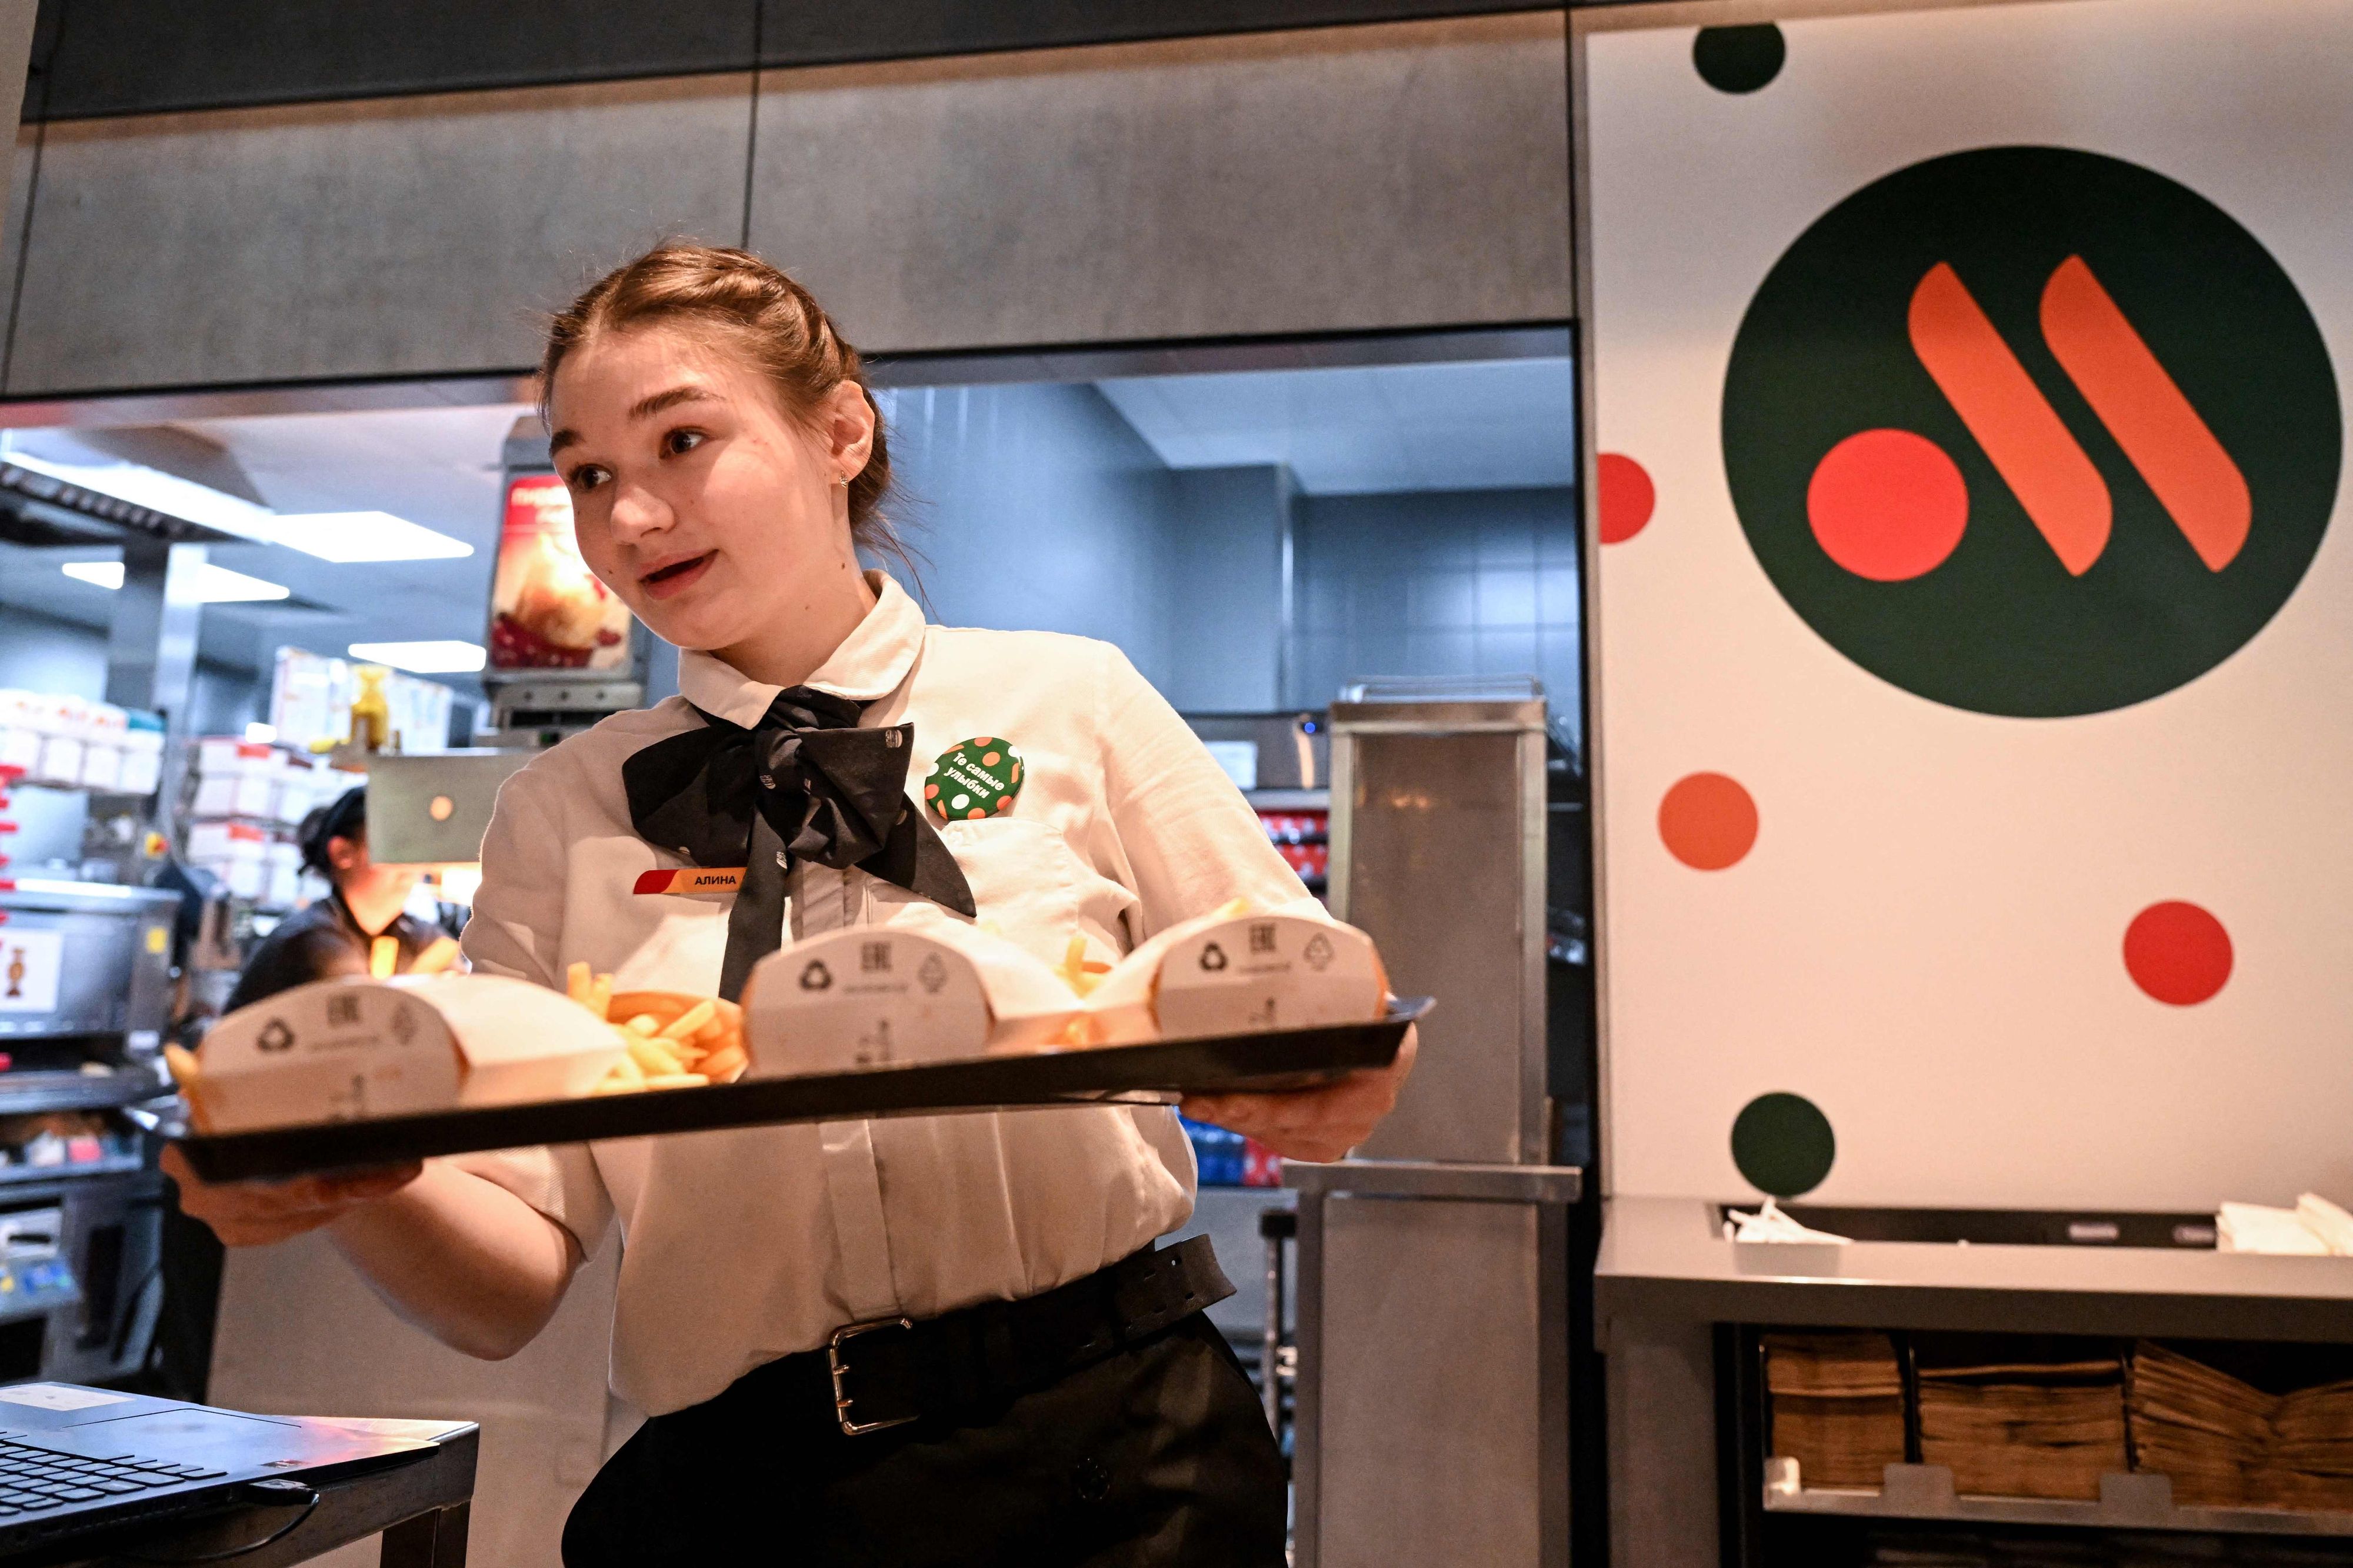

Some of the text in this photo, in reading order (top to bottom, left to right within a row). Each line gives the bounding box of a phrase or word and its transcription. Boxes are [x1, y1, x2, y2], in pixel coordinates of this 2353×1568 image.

[943, 766, 991, 799] улыбки
[953, 752, 1005, 791] Те самые
[695, 875, 736, 885] АЛИНА
